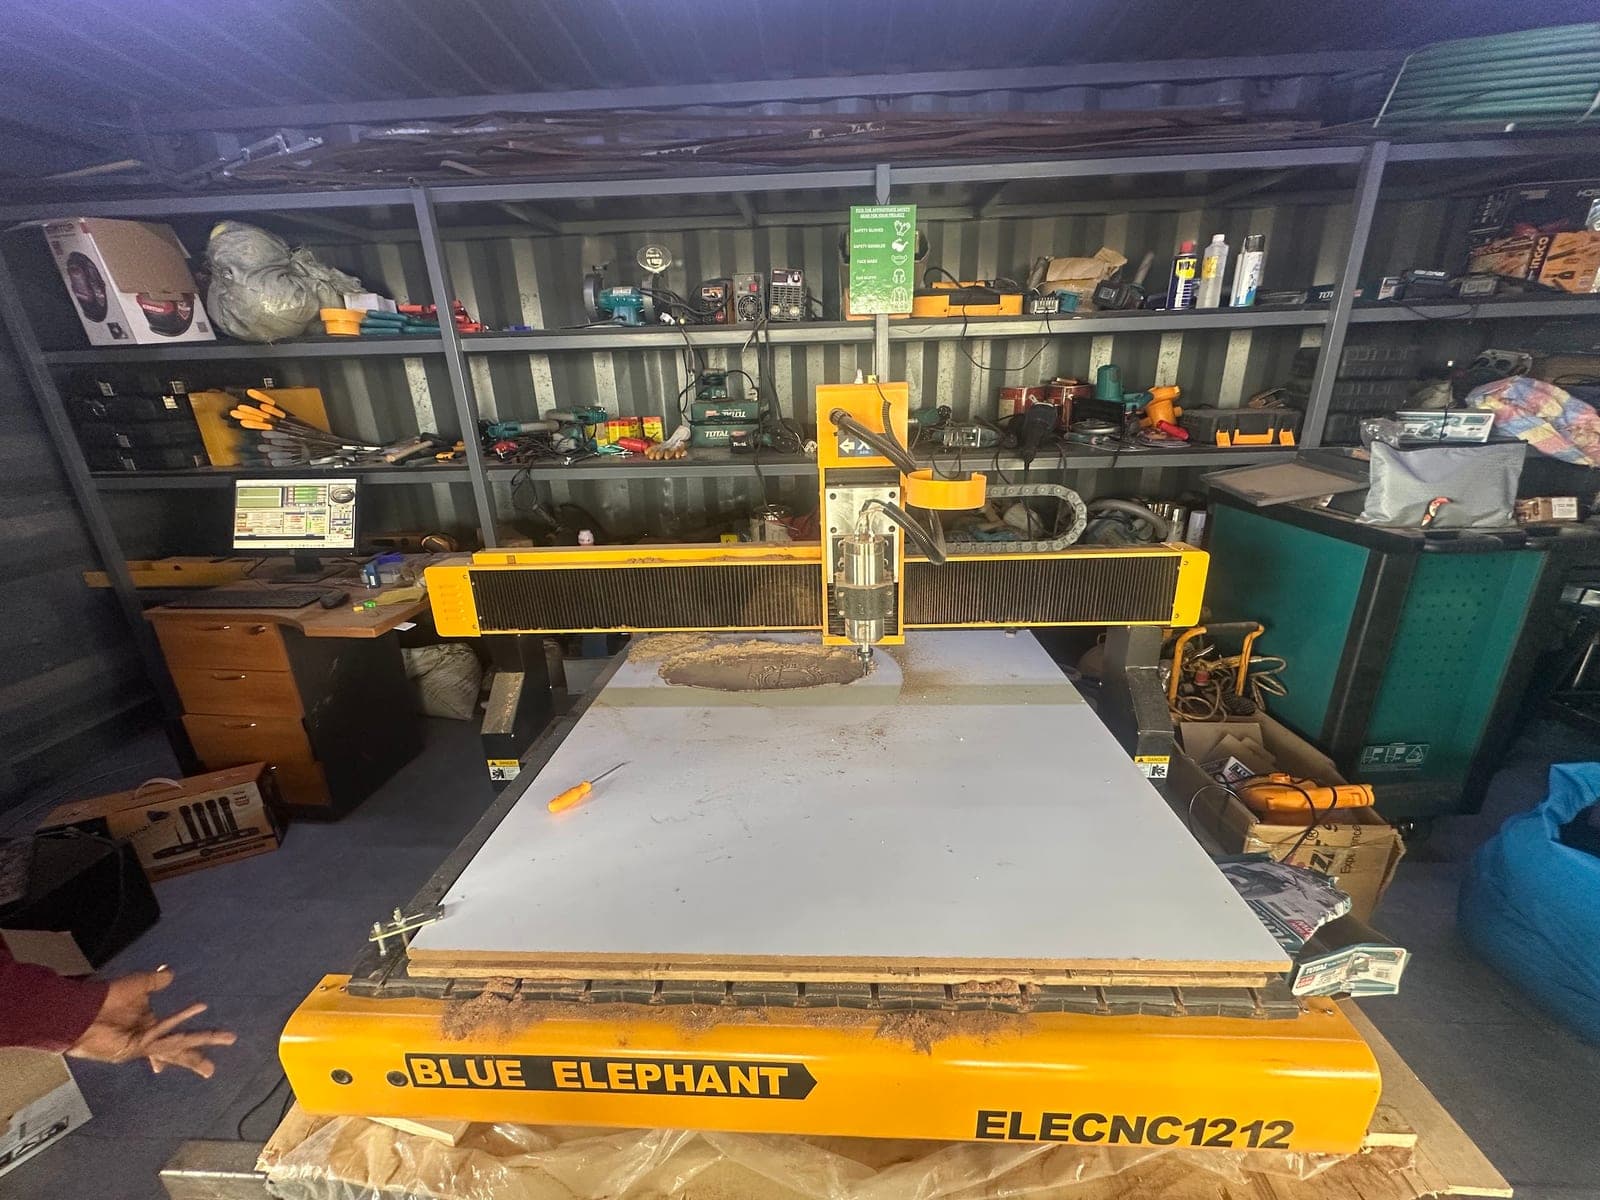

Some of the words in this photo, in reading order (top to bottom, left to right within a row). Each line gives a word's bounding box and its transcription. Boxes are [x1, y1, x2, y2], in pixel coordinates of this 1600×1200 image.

[704, 430, 729, 438] TOTAL
[409, 1057, 526, 1088] BLUE
[552, 1060, 789, 1096] ELEPHANT
[975, 1109, 1295, 1149] ELECNC1212
